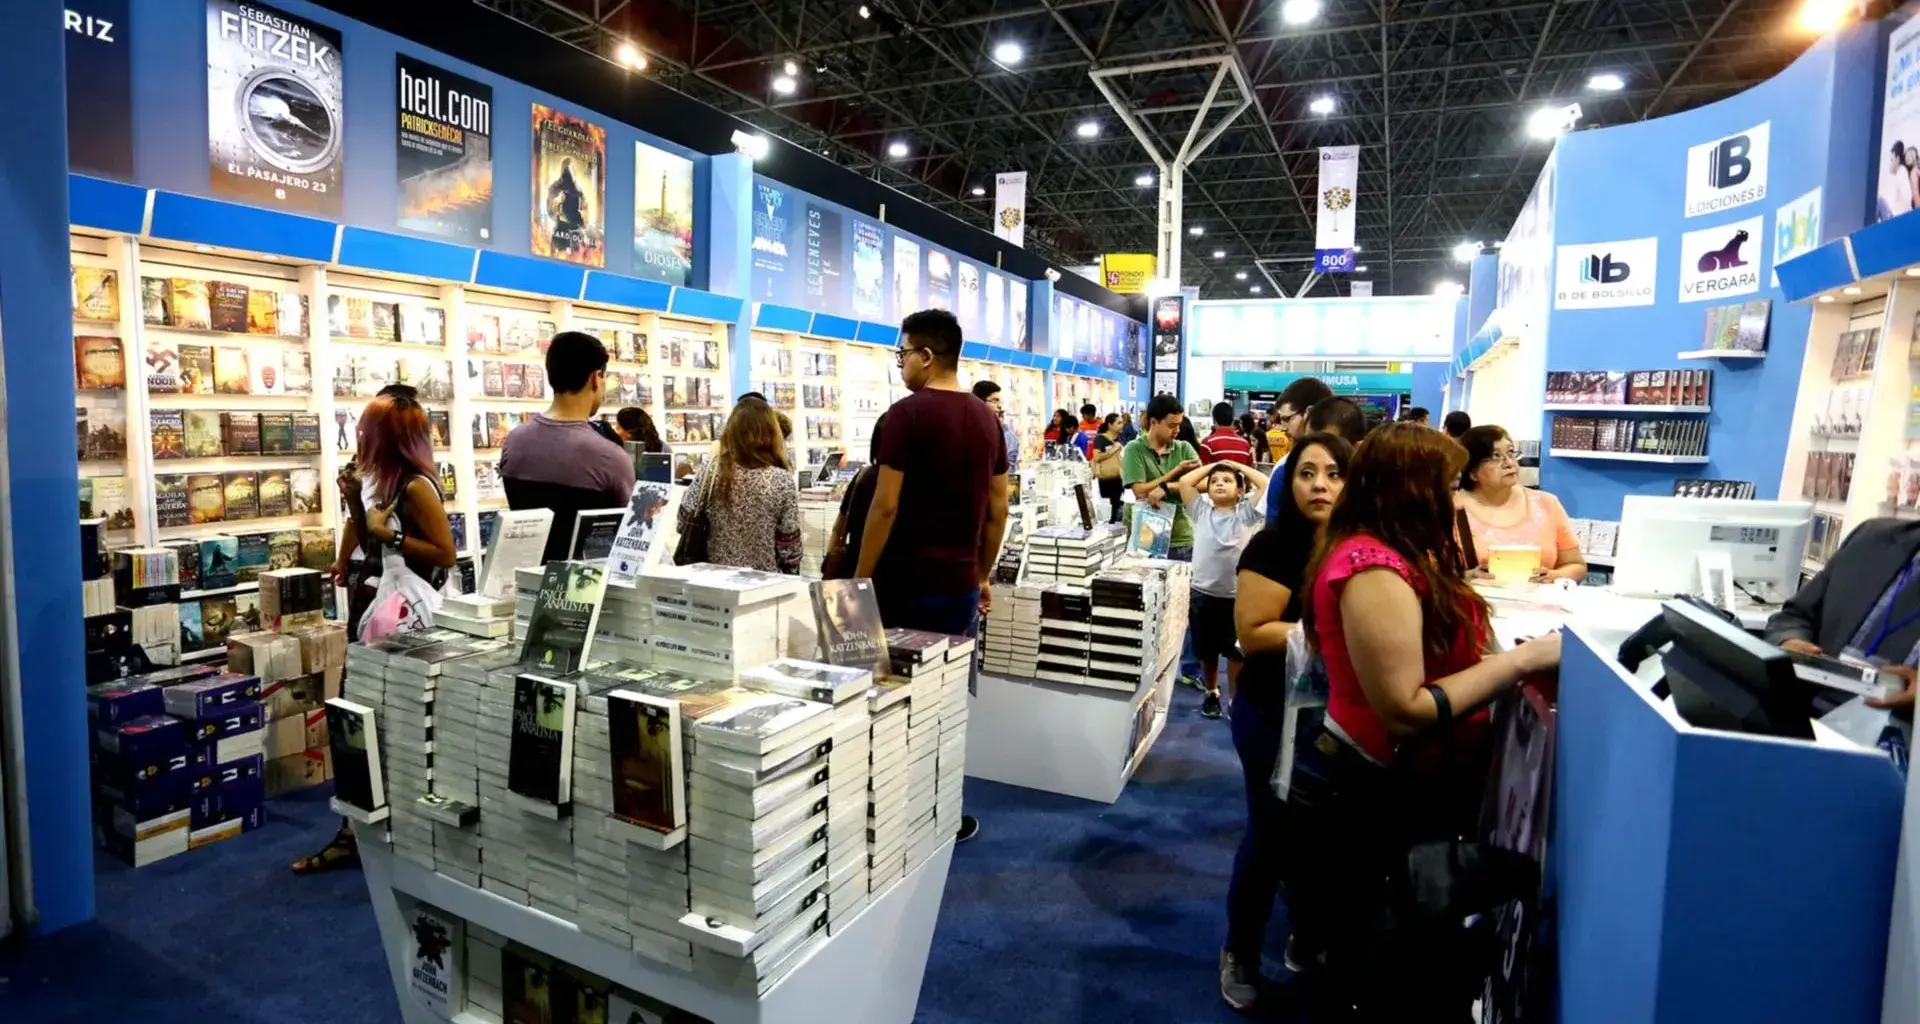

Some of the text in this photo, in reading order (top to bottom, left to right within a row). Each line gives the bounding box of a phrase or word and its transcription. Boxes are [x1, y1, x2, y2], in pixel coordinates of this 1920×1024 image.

[239, 5, 310, 39] SEBASTIAN
[220, 10, 331, 74] FITZEK
[401, 67, 490, 136] hell.com
[228, 162, 328, 194] EL PASAJERO 23
[1688, 184, 1764, 215] EDICIONES B
[807, 209, 821, 297] SEVENEVES
[1321, 254, 1347, 266] 800
[1120, 270, 1145, 278] FONDO
[1684, 273, 1757, 295] VERGARA
[1558, 286, 1652, 300] B DE BOLSILLO
[543, 598, 590, 613] ANALISTA
[842, 629, 868, 642] JOHN
